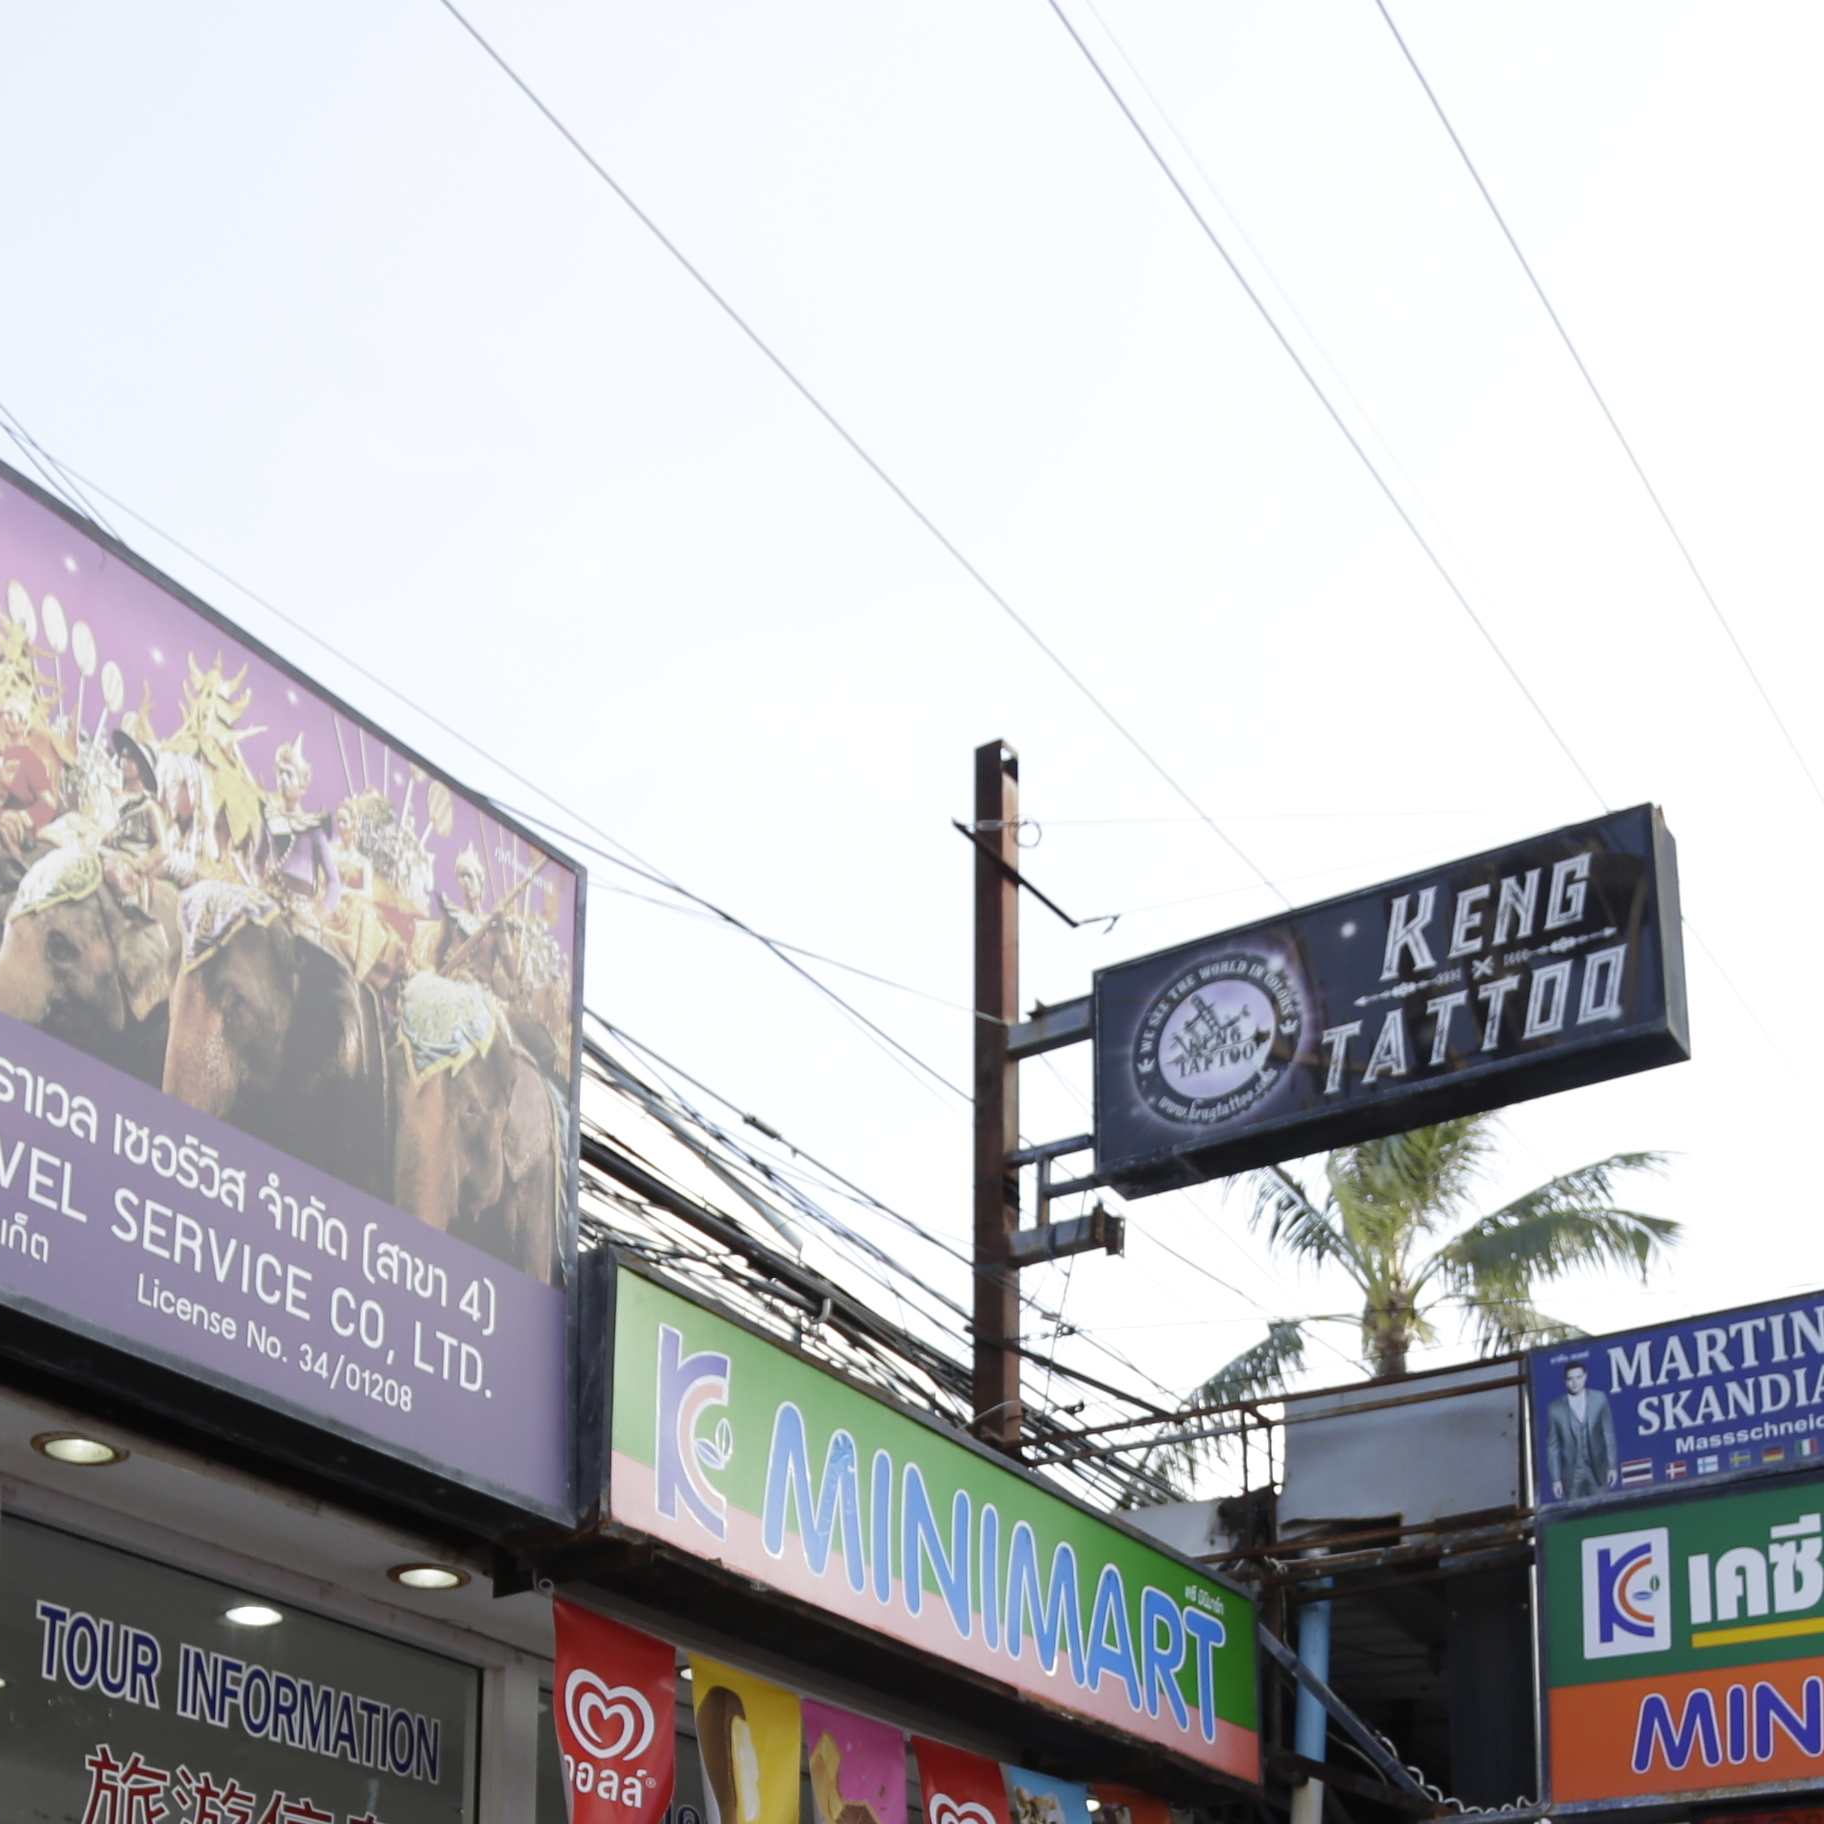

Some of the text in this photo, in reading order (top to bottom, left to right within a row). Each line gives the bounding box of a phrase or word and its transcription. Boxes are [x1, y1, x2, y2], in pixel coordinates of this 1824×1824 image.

[1379, 852, 1593, 982] KENG
[1139, 1029, 1156, 1054] WE
[1167, 972, 1197, 999] THE
[1198, 959, 1248, 979] WORLD
[1321, 943, 1628, 1097] TATTOO
[111, 1187, 313, 1323] SERVICE
[412, 1321, 494, 1399] LTD.
[112, 1111, 247, 1214] เซอร์วิส
[258, 1172, 349, 1262] จำกัด
[361, 1221, 449, 1309] (สาขา
[458, 1276, 497, 1337] 4)
[136, 1272, 413, 1413] License No. 34/01208
[761, 1400, 1227, 1745] MINIMART
[1687, 1513, 1824, 1626] เคซี
[36, 1599, 441, 1785] TOUR INFORMATION
